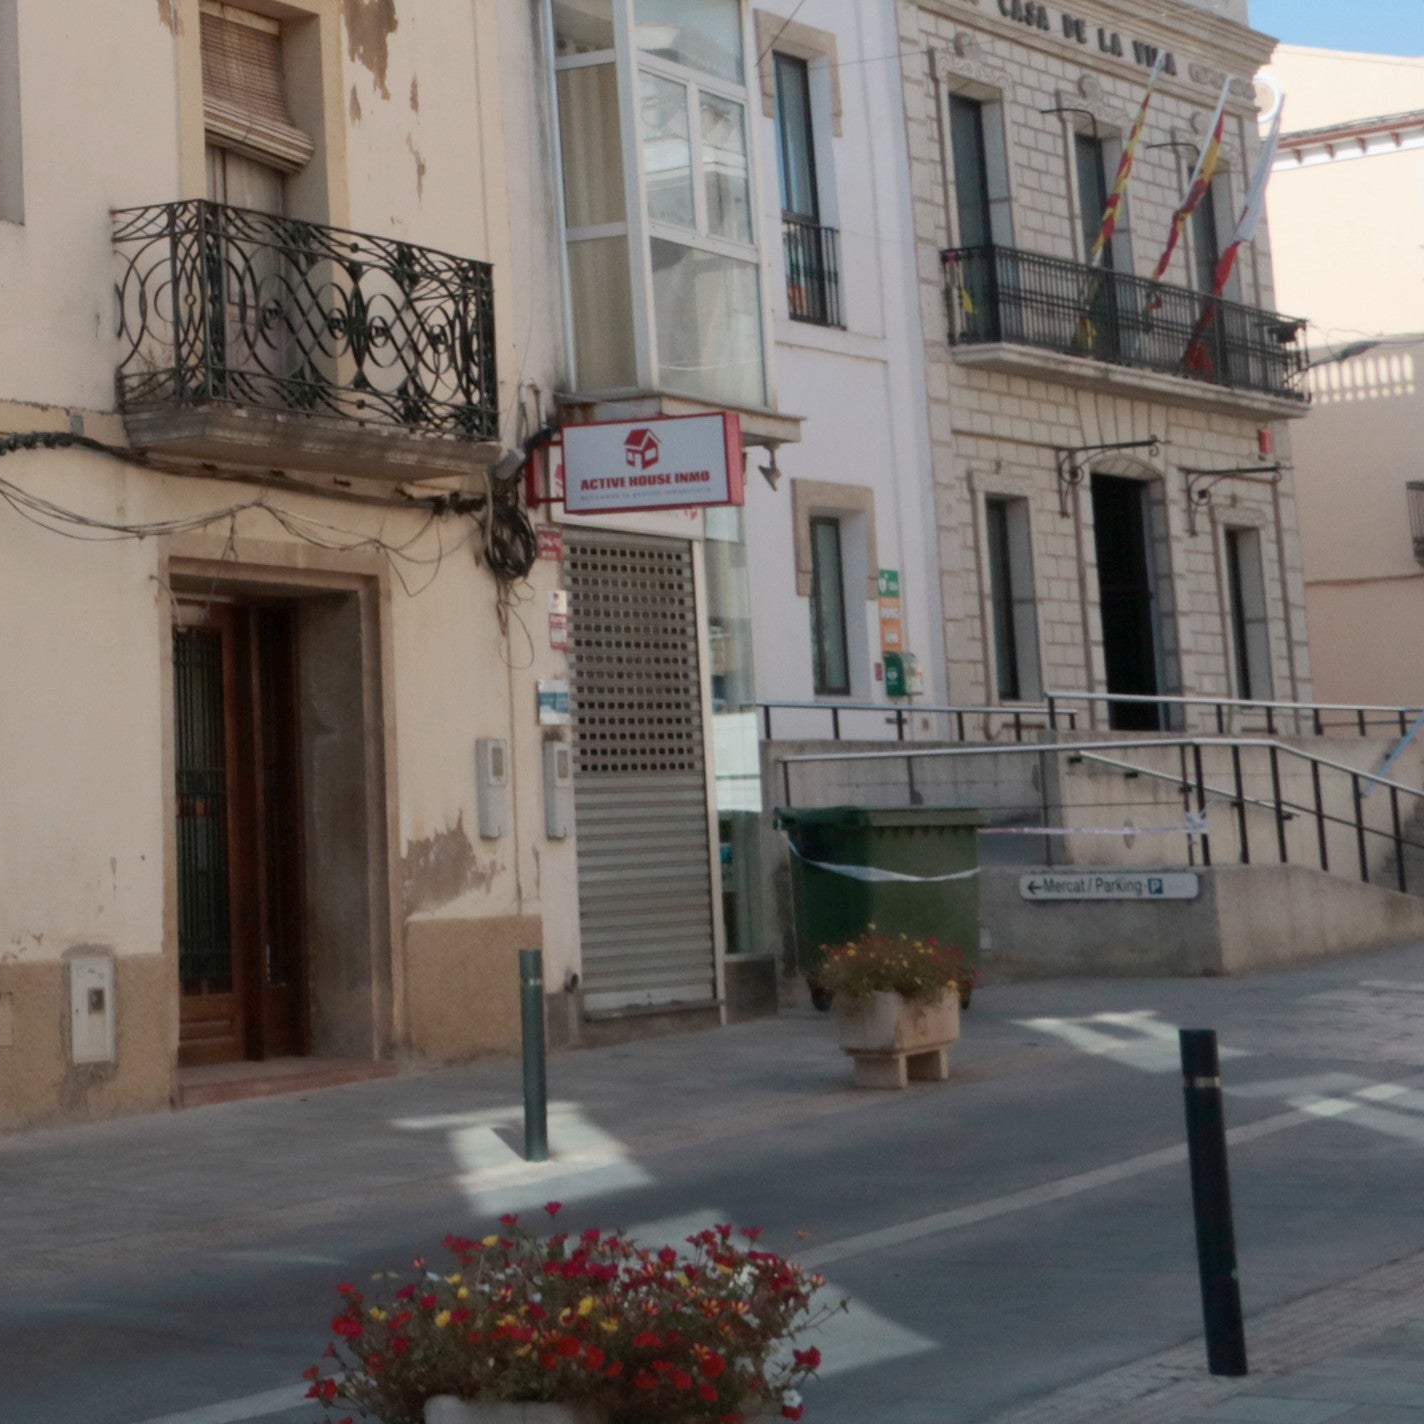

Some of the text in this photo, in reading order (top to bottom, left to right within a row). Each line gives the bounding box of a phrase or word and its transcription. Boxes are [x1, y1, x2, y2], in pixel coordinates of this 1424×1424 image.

[1061, 13, 1088, 44] DE
[1097, 28, 1124, 57] LA
[580, 470, 710, 491] ACTIVE HOUSE INMO
[1043, 877, 1085, 893] Mercat
[1095, 877, 1143, 896] Parking
